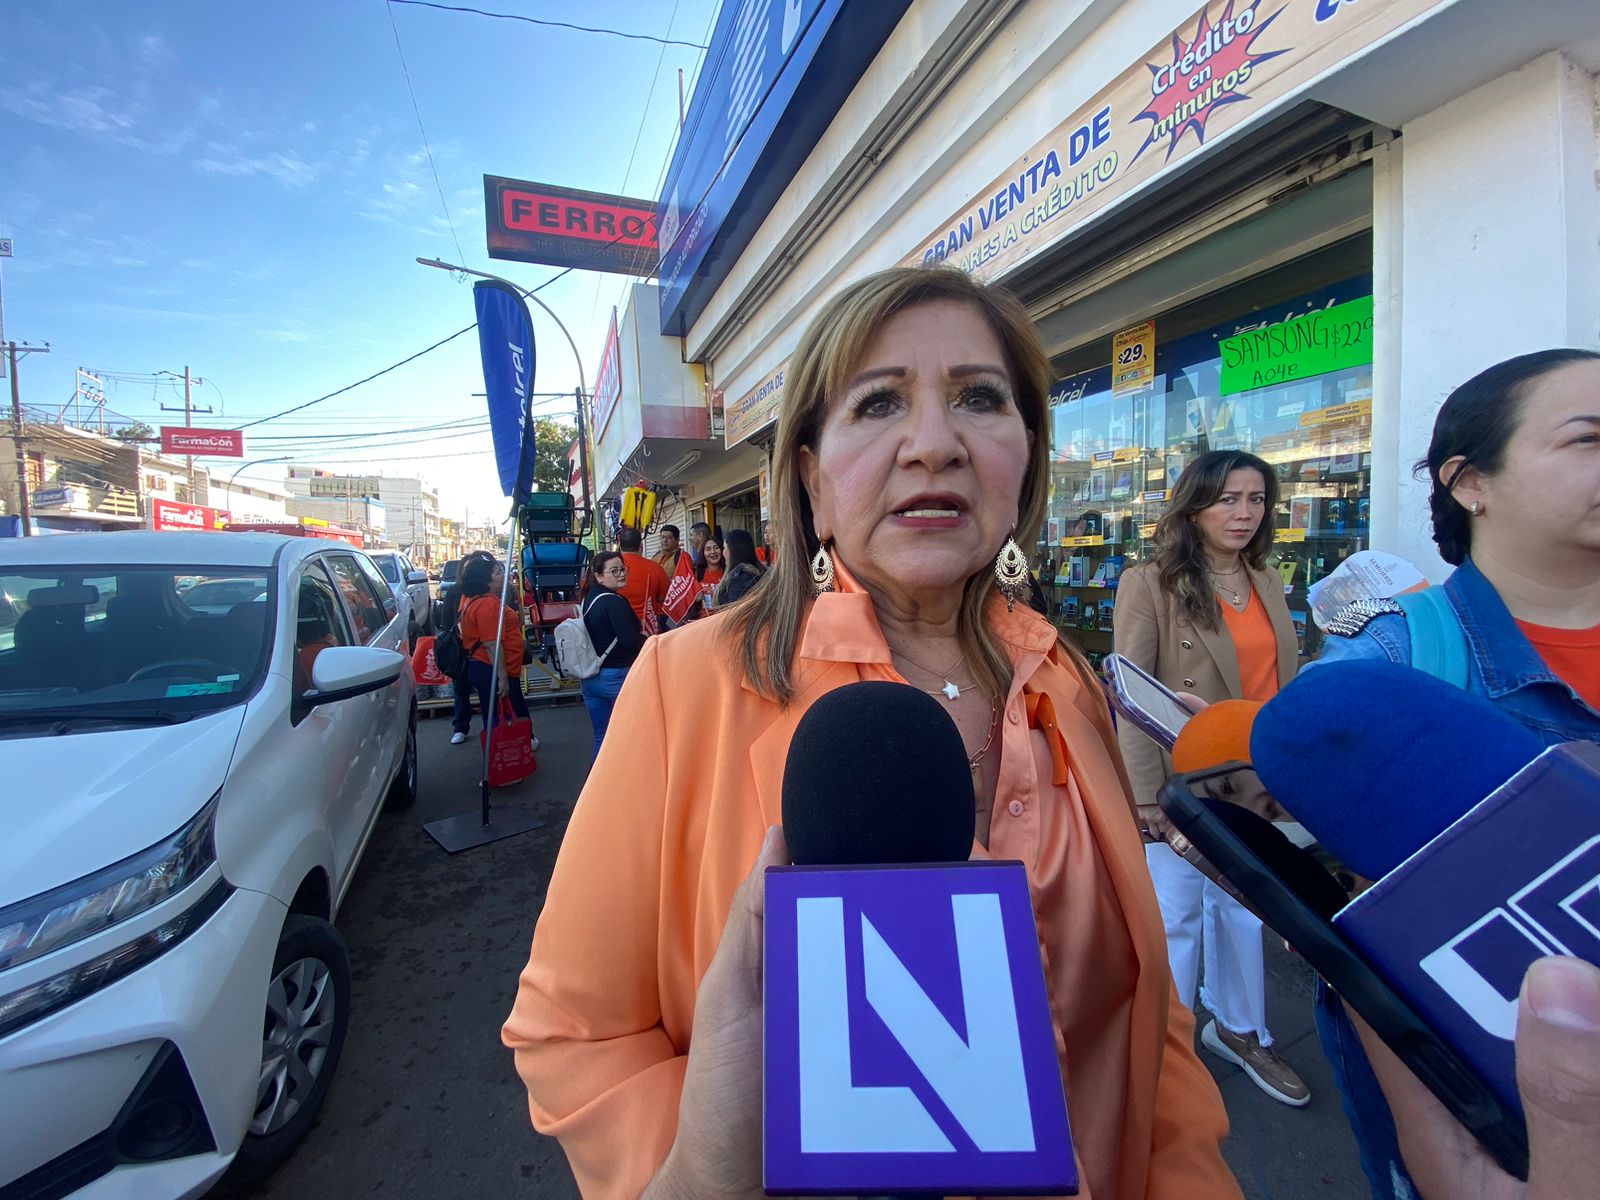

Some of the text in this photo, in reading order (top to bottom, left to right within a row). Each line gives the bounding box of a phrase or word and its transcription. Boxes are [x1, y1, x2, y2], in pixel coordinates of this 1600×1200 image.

[1152, 8, 1254, 95] Crédito
[1188, 65, 1211, 91] en
[1153, 60, 1252, 141] minutos
[923, 106, 1110, 266] GRAN VENTA DE
[960, 151, 1118, 272] ARES A CRÉDITO
[775, 371, 784, 389] DE
[1224, 316, 1329, 369] SAMSUNG
